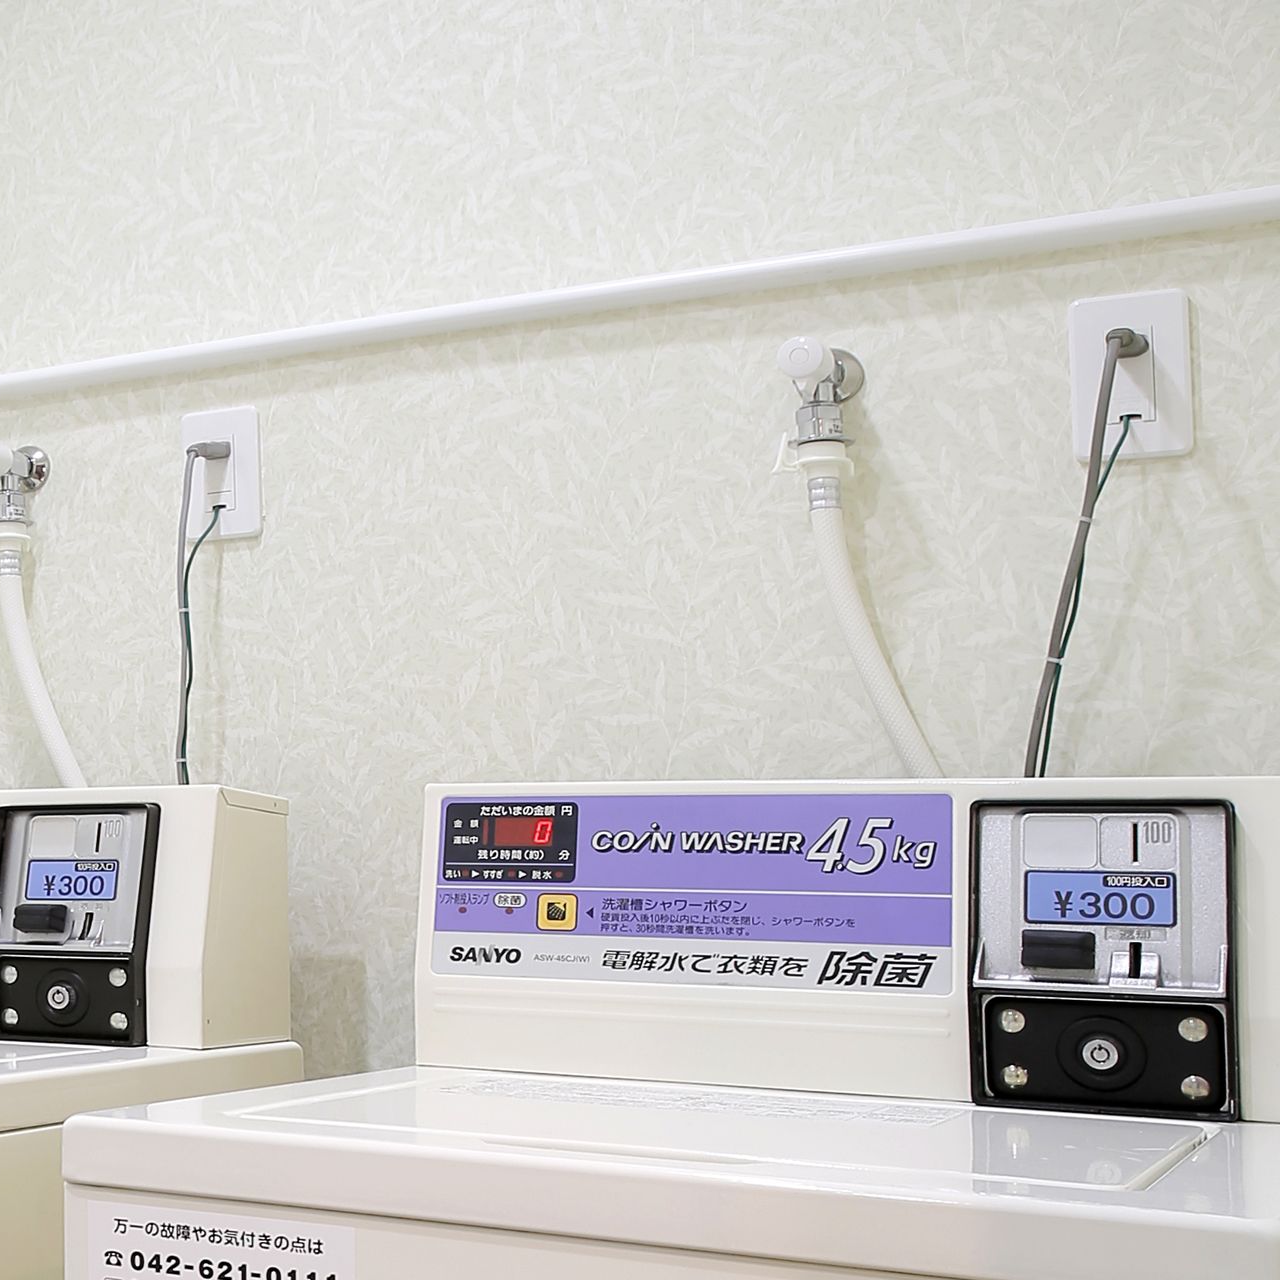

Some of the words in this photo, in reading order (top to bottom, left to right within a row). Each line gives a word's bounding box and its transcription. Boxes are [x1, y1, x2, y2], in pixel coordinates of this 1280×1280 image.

[480, 805, 556, 816] ただいまの金額
[561, 805, 573, 816] 円
[534, 821, 552, 843] 0
[591, 821, 674, 853] COIN
[680, 831, 805, 854] WASHER
[1143, 820, 1172, 844] 100
[558, 849, 570, 860] 分
[43, 875, 105, 897] ¥300
[1106, 875, 1168, 888] 100円投入口
[601, 898, 748, 914] 洗濯槽シャワーボタン
[1053, 889, 1155, 920] ¥300
[449, 945, 522, 965] SANYO
[601, 949, 809, 978] 電解水で衣類を
[817, 950, 937, 989] 除菌
[113, 1217, 325, 1255] 万一の故障やお気付きの点は
